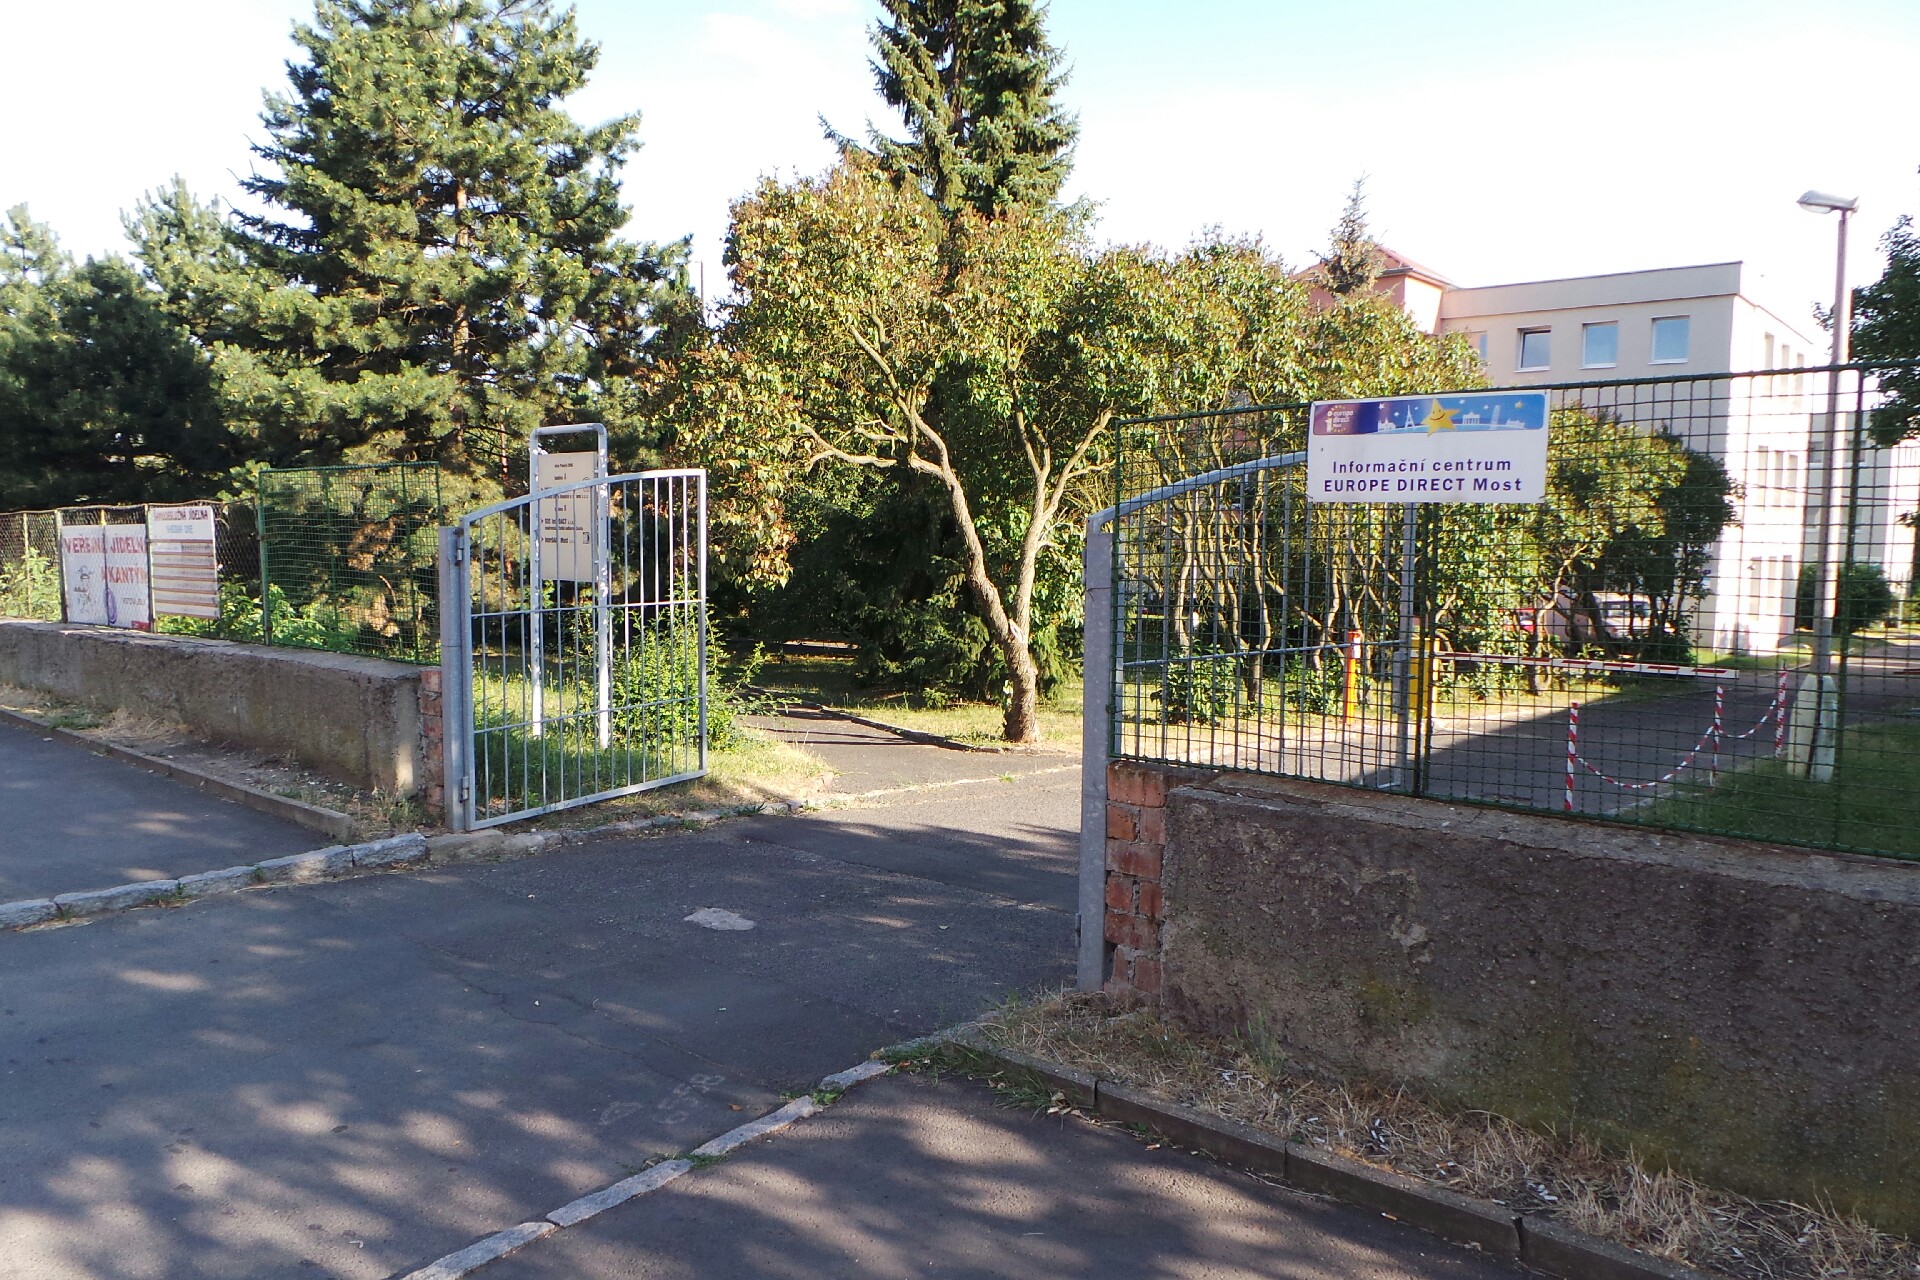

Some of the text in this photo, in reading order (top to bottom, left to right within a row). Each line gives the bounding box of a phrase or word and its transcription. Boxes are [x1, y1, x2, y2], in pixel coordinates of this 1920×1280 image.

[1333, 458, 1511, 473] Informační centrum
[1324, 477, 1522, 492] EUROPE DIRECT Most
